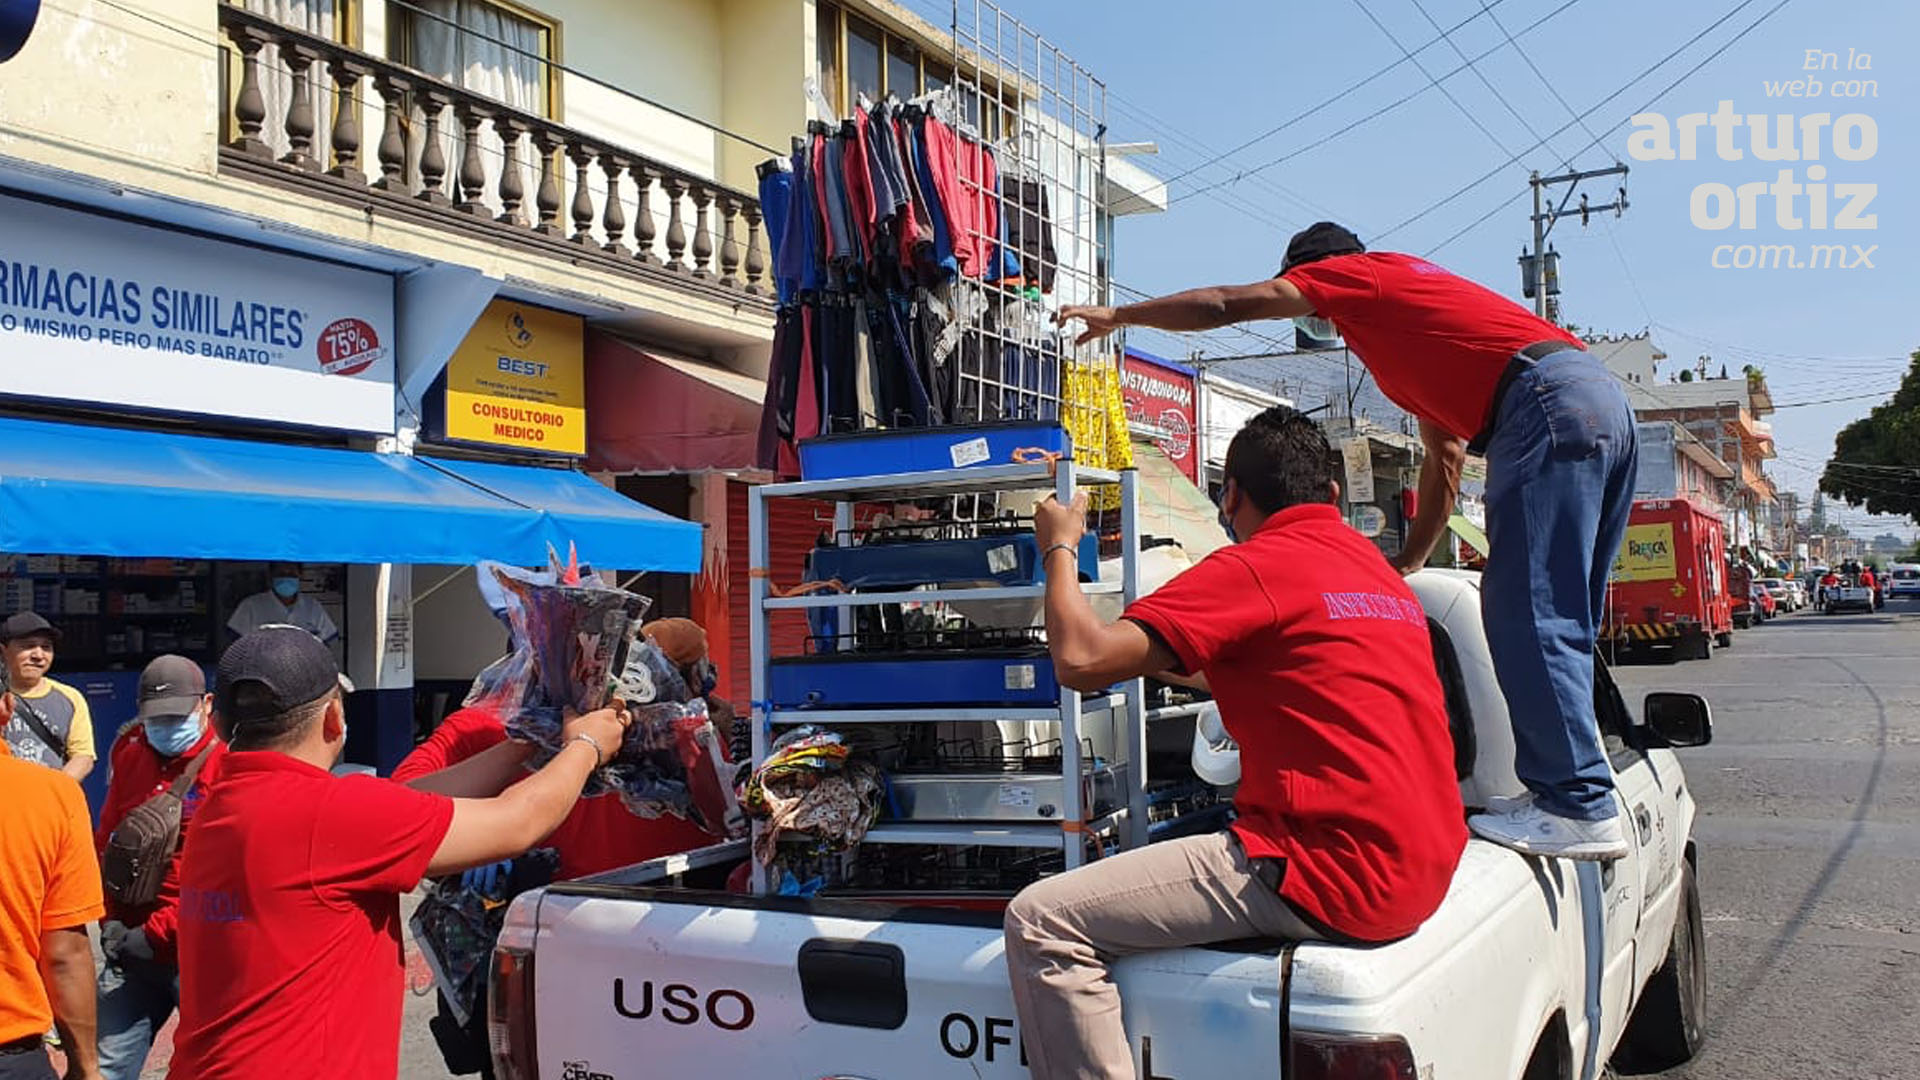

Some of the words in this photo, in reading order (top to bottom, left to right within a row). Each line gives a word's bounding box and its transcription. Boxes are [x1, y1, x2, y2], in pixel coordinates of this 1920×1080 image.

[151, 285, 302, 348] SIMILARES
[24, 316, 92, 342] MISMO
[99, 327, 151, 349] PERO
[157, 336, 196, 355] MAS
[202, 342, 270, 365] BARATO
[325, 327, 368, 359] 75%
[497, 356, 548, 378] BEST
[472, 402, 564, 427] CONSULTORIO
[494, 423, 544, 442] MEDICO
[613, 977, 755, 1031] USO
